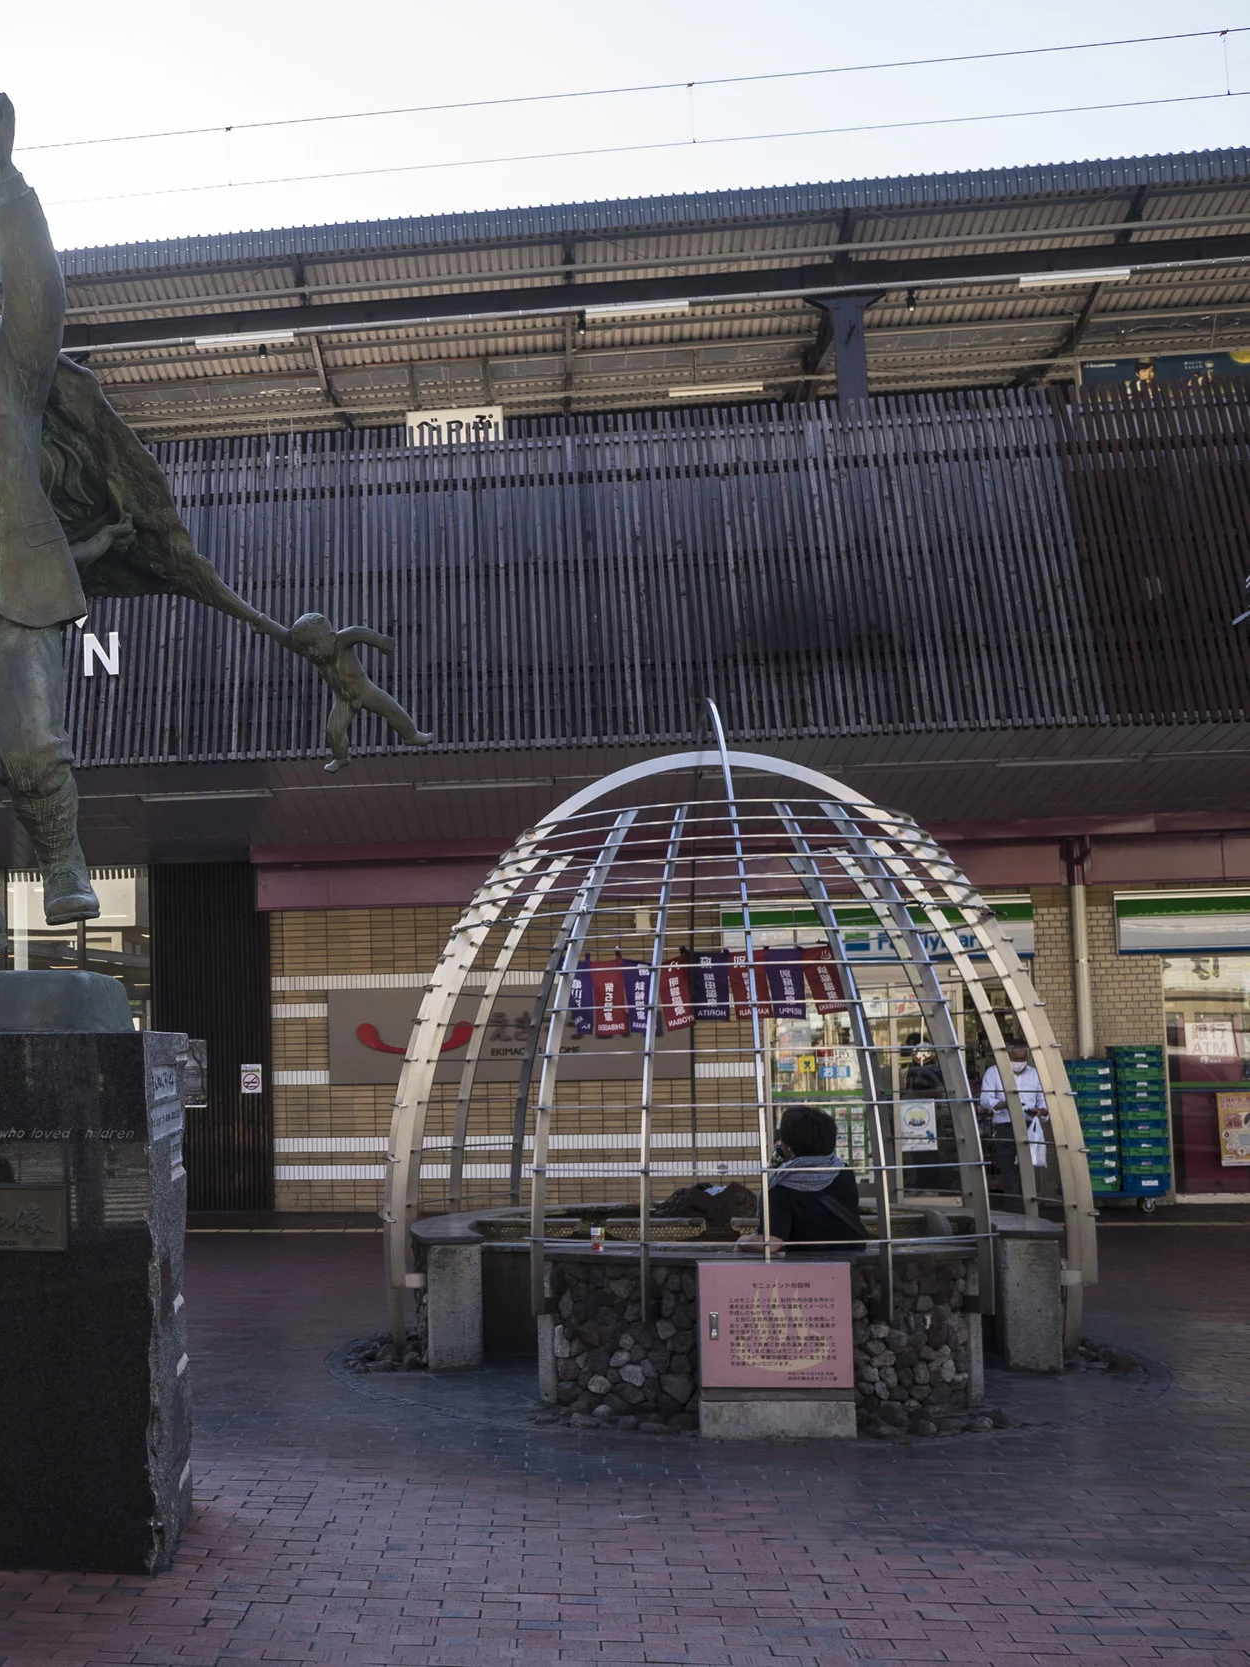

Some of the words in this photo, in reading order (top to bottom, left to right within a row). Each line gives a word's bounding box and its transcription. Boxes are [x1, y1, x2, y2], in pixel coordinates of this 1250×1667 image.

[1193, 1042, 1228, 1054] ATM
[0, 1127, 25, 1139] who
[30, 1127, 72, 1139] loved
[84, 1128, 136, 1139] hildren
